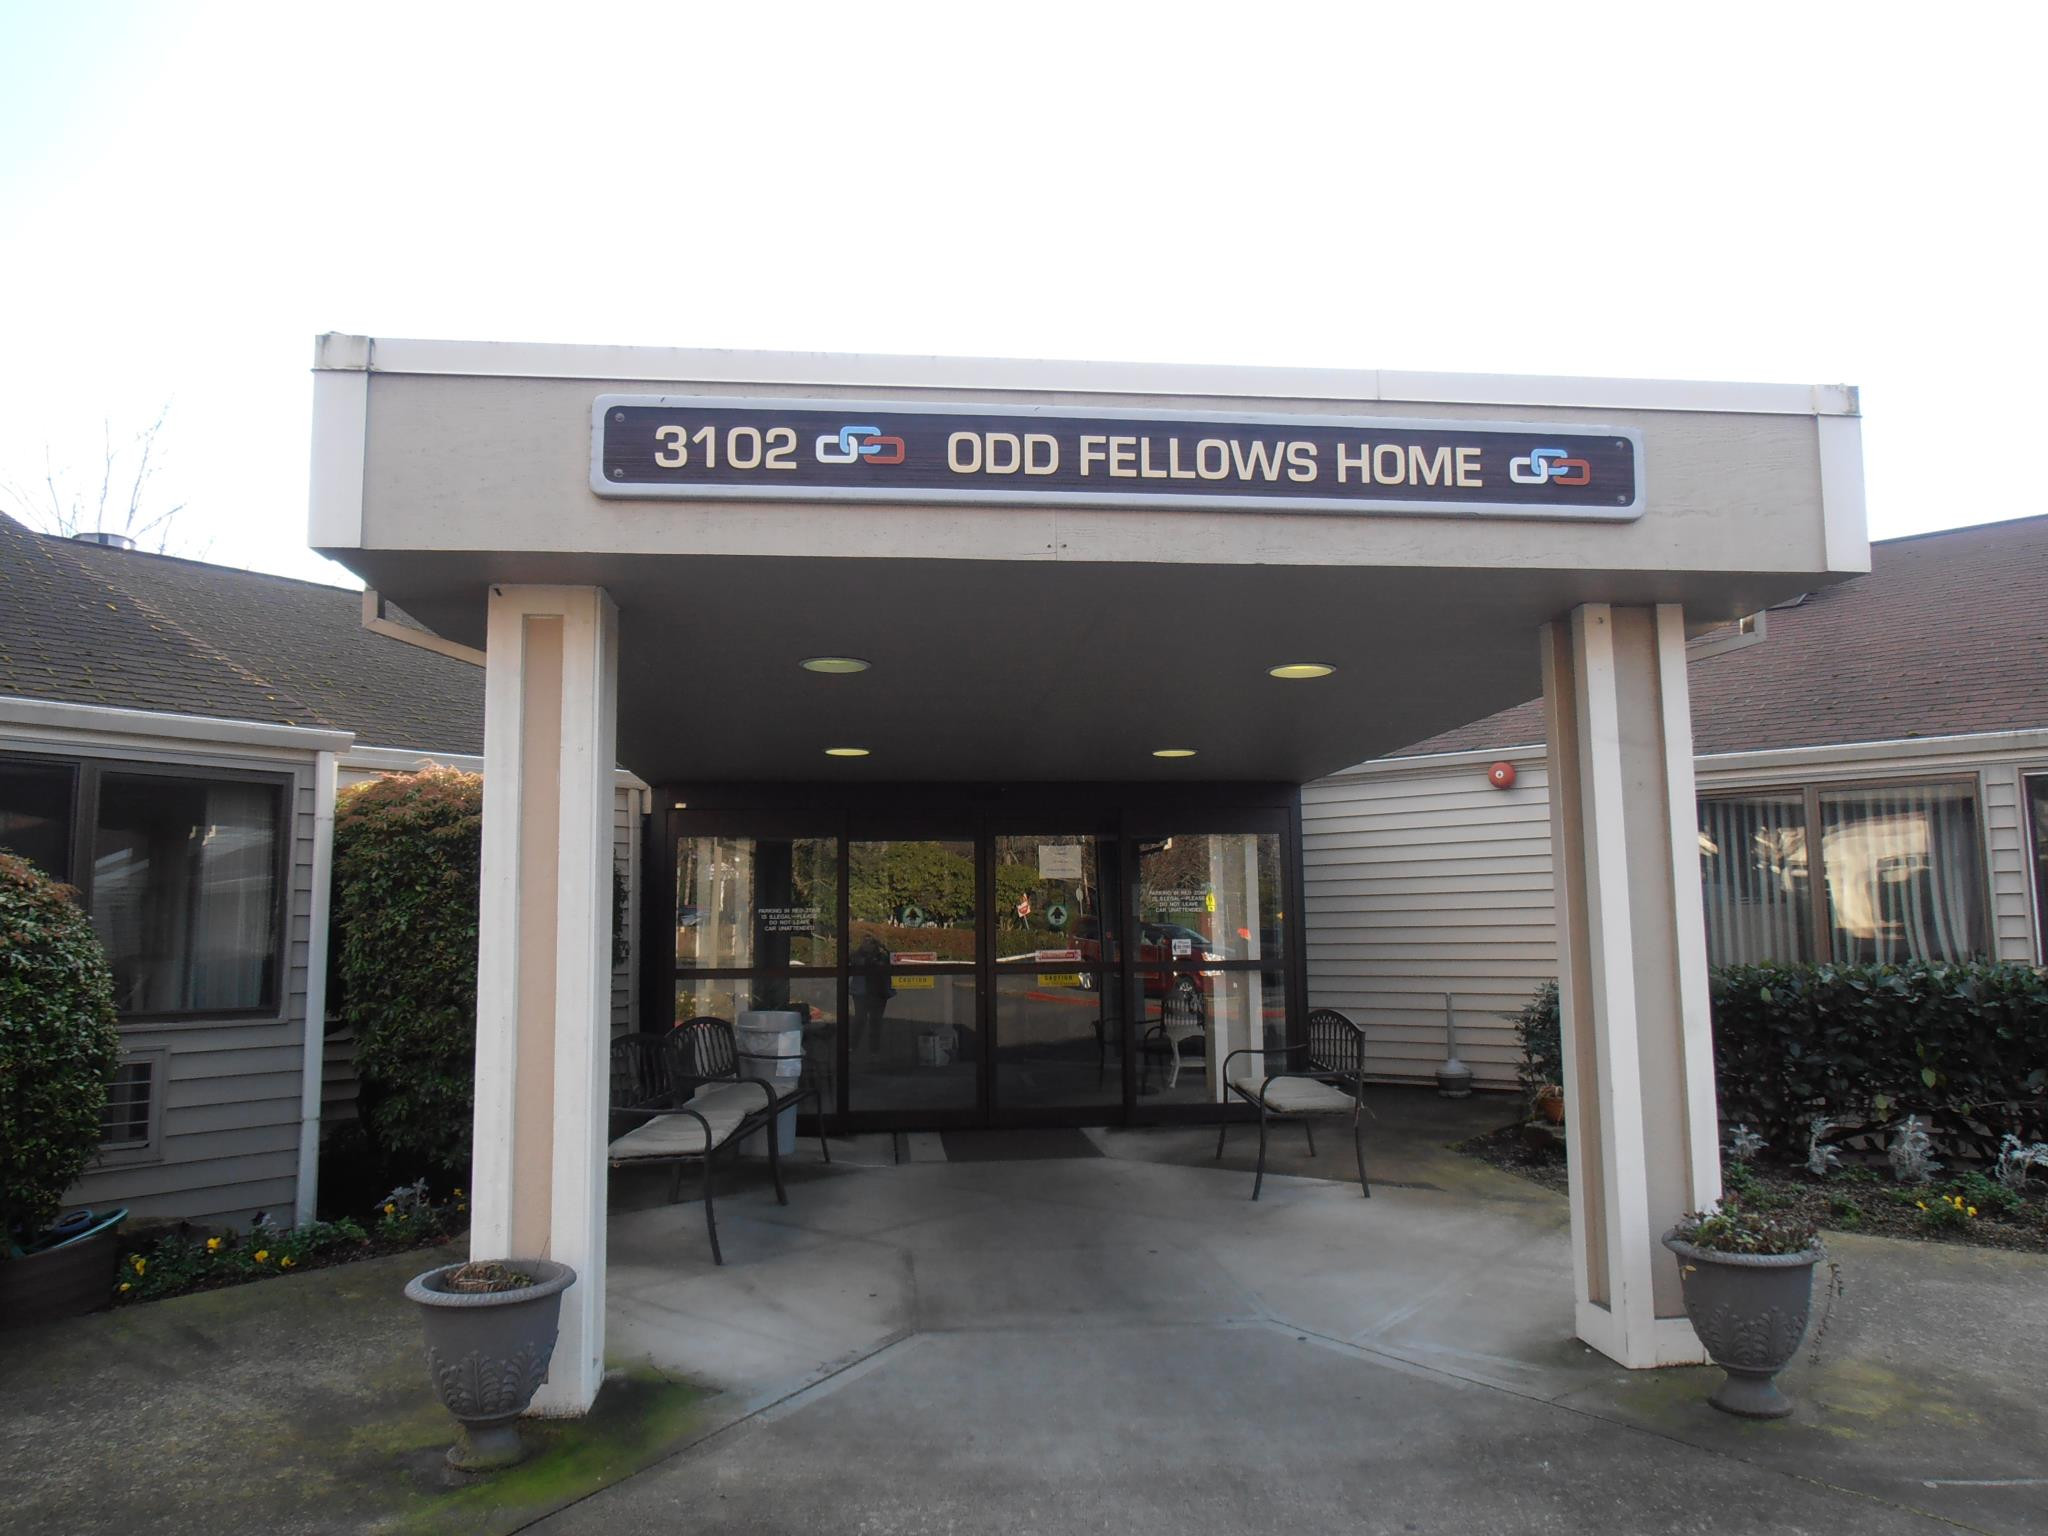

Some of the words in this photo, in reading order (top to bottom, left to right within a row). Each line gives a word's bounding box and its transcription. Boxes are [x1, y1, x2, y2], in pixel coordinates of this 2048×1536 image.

[654, 425, 798, 470] 3102
[947, 431, 1059, 475] ODD
[1079, 435, 1318, 483] FELLOWS
[1337, 443, 1483, 487] HOME
